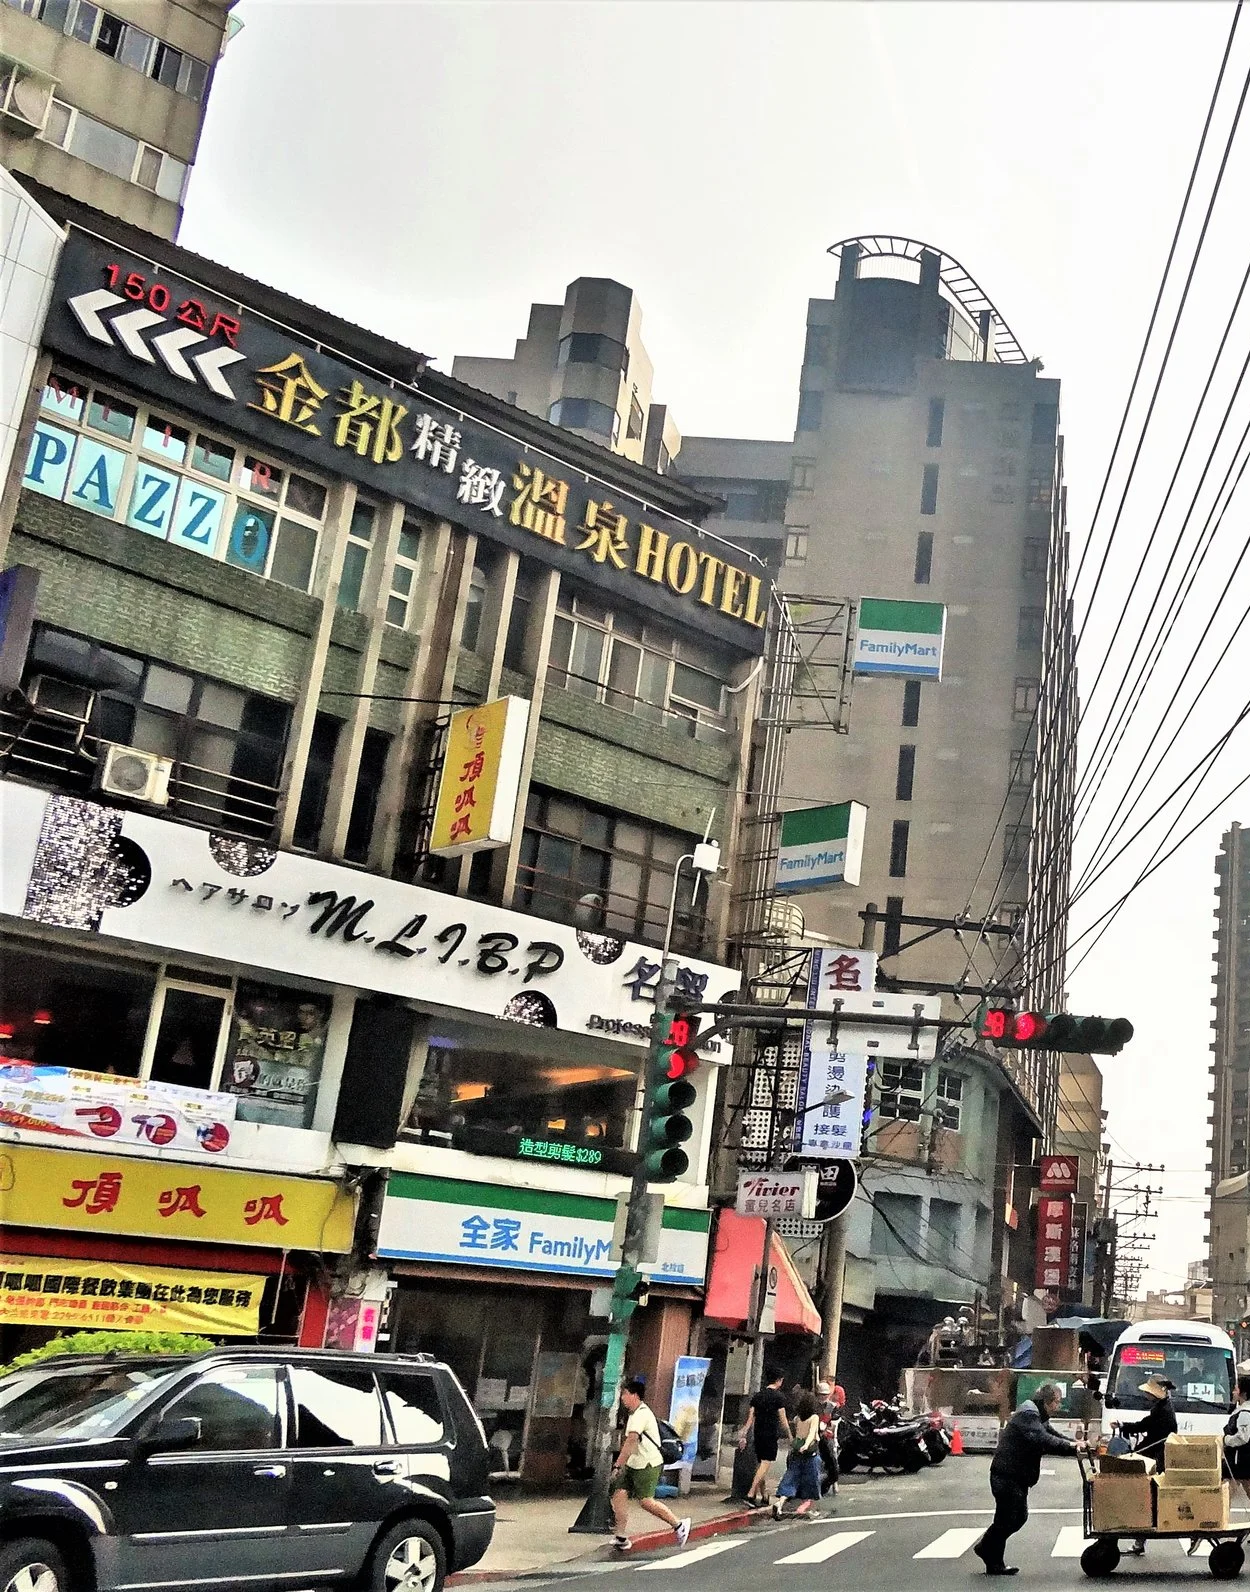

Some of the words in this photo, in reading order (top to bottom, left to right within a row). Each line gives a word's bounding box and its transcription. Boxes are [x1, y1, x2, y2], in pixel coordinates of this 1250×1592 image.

[105, 263, 241, 349] 150公尺
[25, 429, 269, 564] PAZZO
[634, 522, 767, 628] HOTEL
[860, 638, 937, 658] FamilyMart
[450, 751, 485, 840] 頂呱呱
[780, 850, 844, 871] FamilyMart
[170, 877, 300, 920] ヘアサロン
[62, 1171, 290, 1227] 頂呱呱
[459, 1214, 522, 1255] 全家
